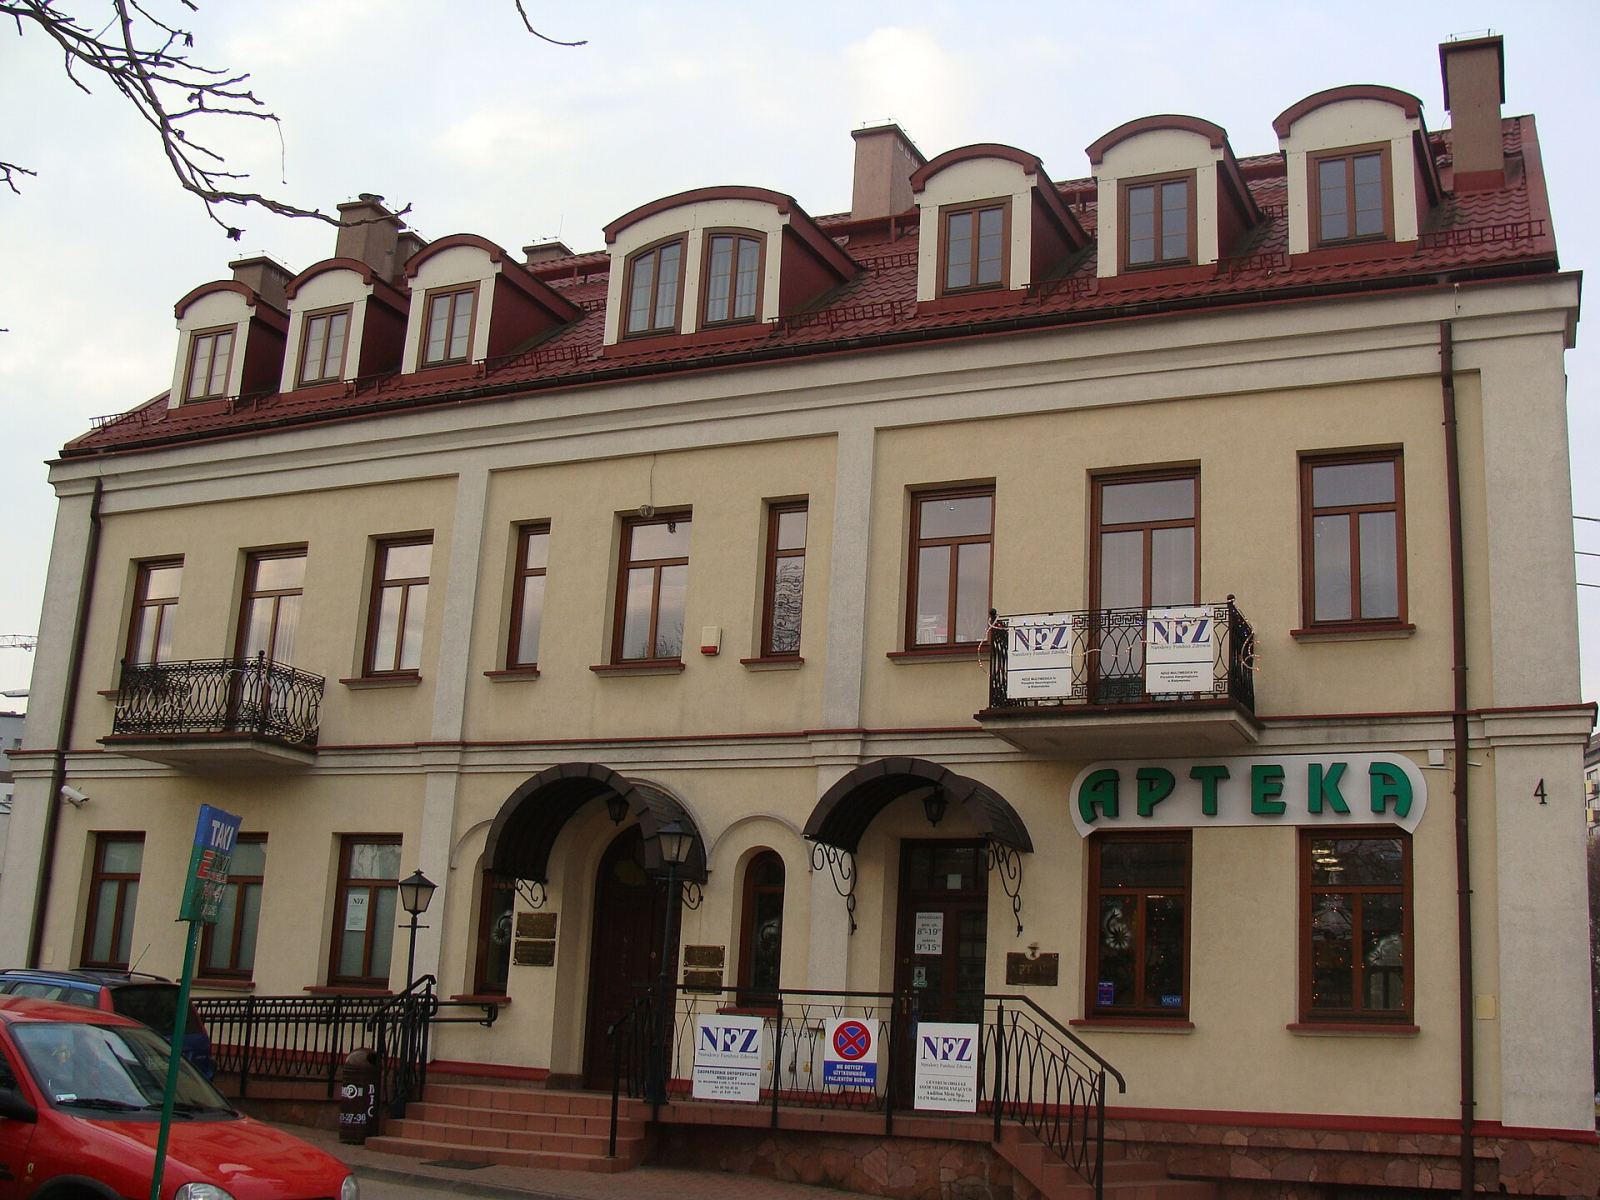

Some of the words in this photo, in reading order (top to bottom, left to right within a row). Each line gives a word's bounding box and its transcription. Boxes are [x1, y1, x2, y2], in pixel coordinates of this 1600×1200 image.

[1012, 627, 1068, 652] NFZ
[1151, 619, 1211, 645] NFZ
[1078, 761, 1413, 824] APTEKA
[1533, 778, 1547, 804] 4
[699, 1026, 758, 1053] NFZ
[921, 1036, 972, 1062] NFZ
